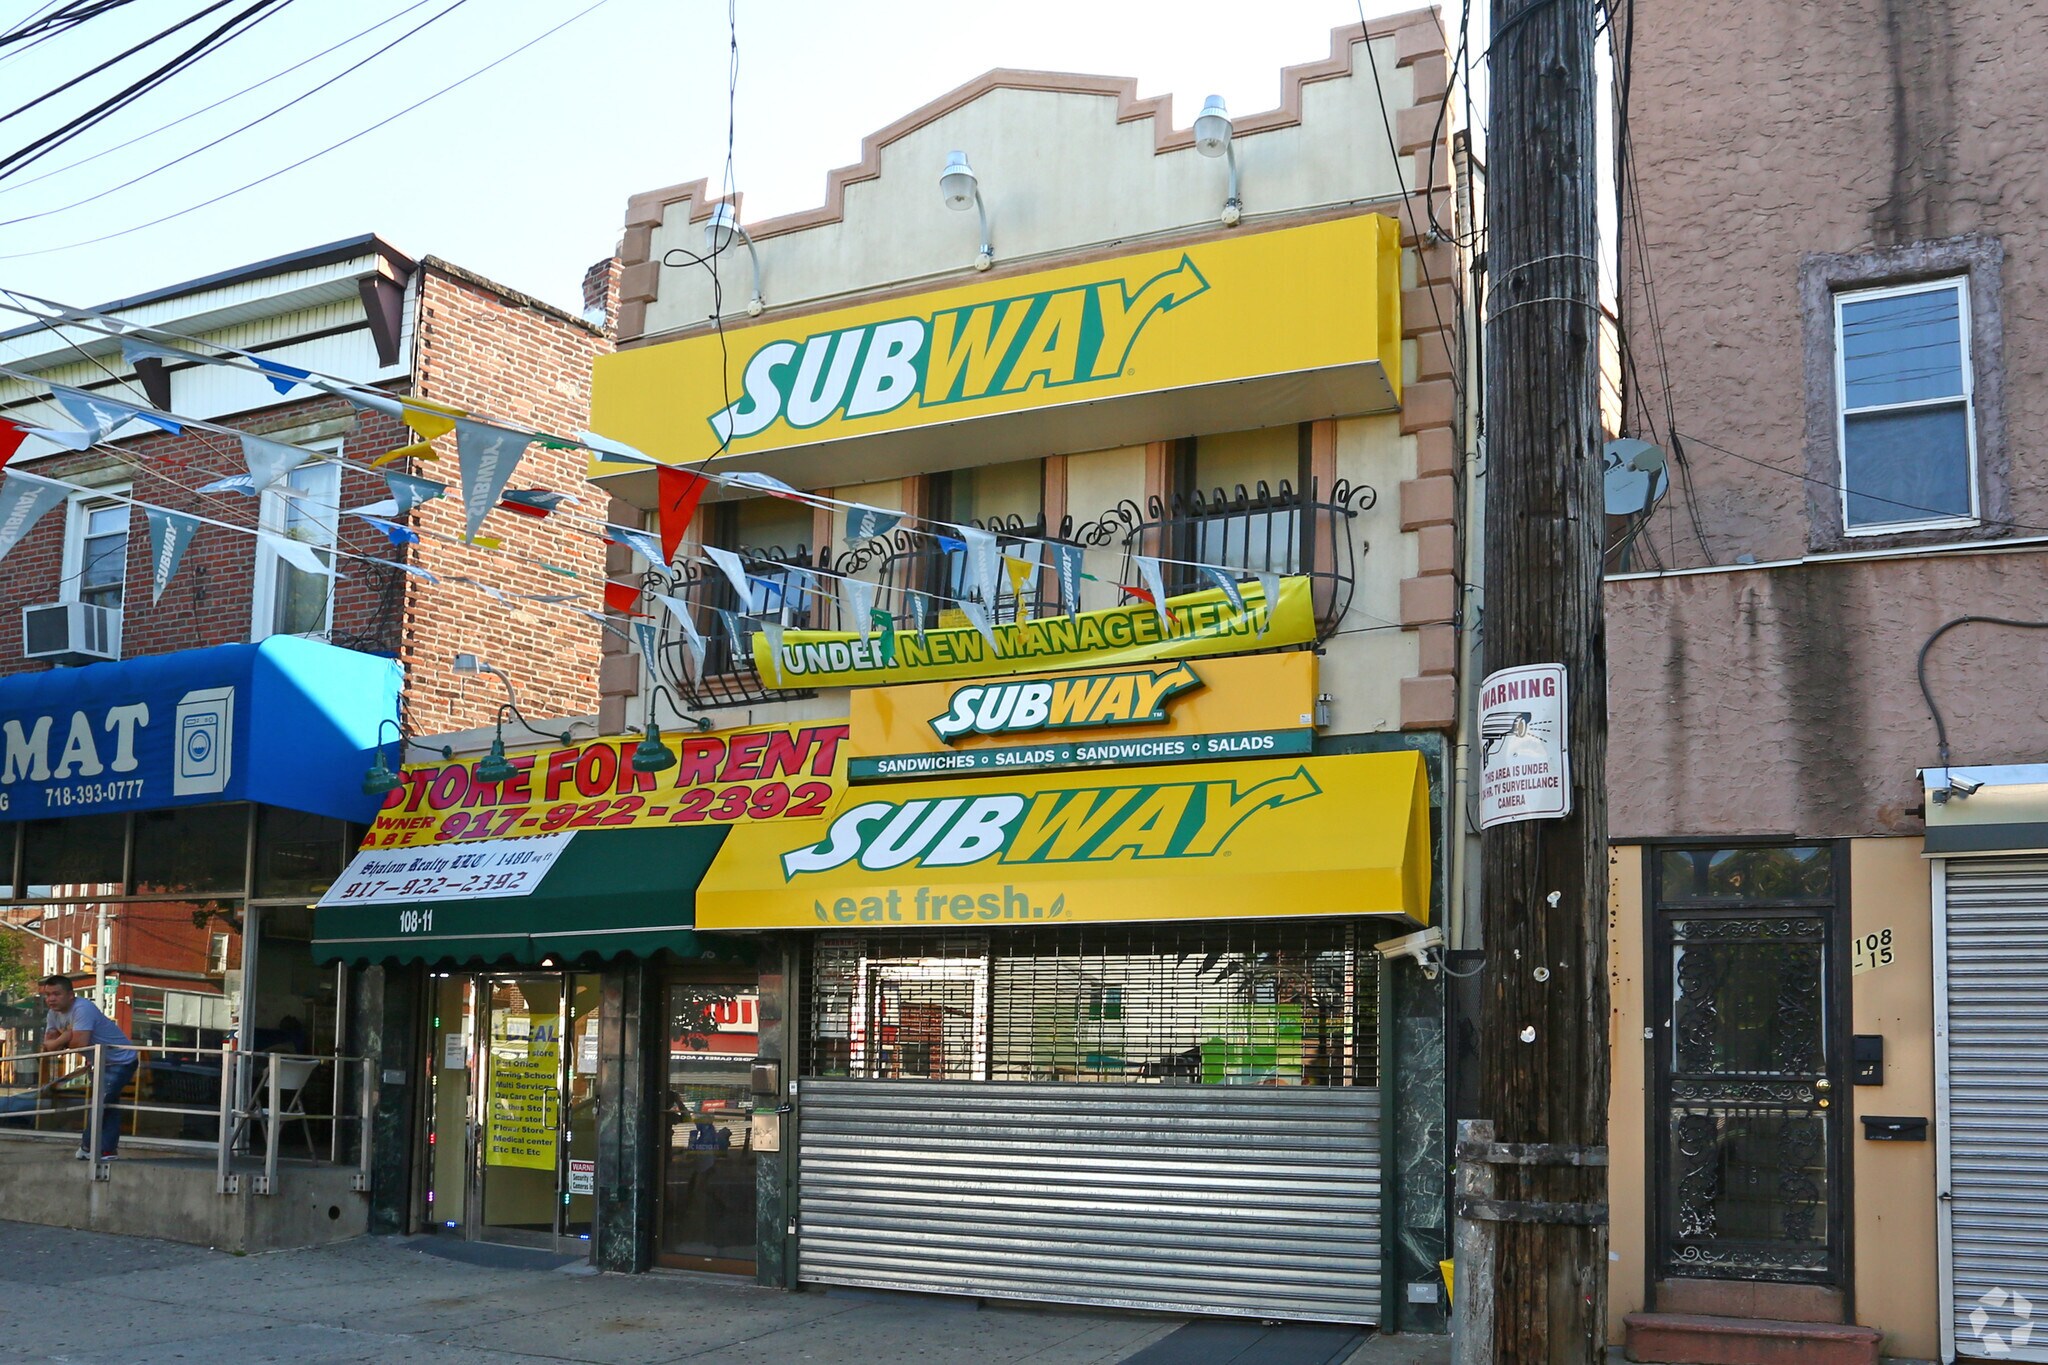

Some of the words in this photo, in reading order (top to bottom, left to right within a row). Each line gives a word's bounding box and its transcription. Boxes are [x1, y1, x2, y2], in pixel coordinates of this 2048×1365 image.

[707, 253, 1211, 452] SUBWAY
[155, 516, 179, 589] SUBWAY
[1061, 547, 1077, 612] SUBWAY
[782, 638, 900, 676] UNDER
[901, 630, 986, 668] NEW
[991, 595, 1271, 661] MANAGEMENT
[928, 661, 1206, 745] SUBWAY
[1482, 677, 1555, 711] WARNING
[1, 702, 149, 784] MAT
[877, 755, 975, 773] SANDWICHES
[995, 749, 1055, 766] SALADS
[1076, 742, 1185, 762] SANDWICHES
[1207, 735, 1274, 752] SALADS
[545, 741, 657, 801] FOR
[674, 724, 850, 788] RENT
[1485, 771, 1495, 784] THIS
[1495, 767, 1511, 781] AREA
[1512, 765, 1520, 777] IS
[1521, 762, 1549, 776] UNDER
[46, 779, 144, 807] 718-393-0777
[1494, 782, 1502, 795] TV
[1502, 776, 1559, 794] SURVEILLANCE
[434, 781, 832, 842] 917-922-2392
[1497, 794, 1526, 809] CAMERA
[376, 816, 436, 830] WNER
[780, 765, 1322, 883] SUBWAY
[359, 860, 407, 878] Shalom
[407, 857, 449, 873] Realty
[496, 850, 535, 866] 1480
[340, 871, 528, 899] 917-922-2392
[833, 888, 902, 922] eat
[915, 885, 1044, 921] fresh.
[400, 909, 433, 933] 108-11
[1855, 928, 1892, 955] 108
[495, 1071, 522, 1080] Driving
[524, 1072, 555, 1080] School
[496, 1081, 514, 1089] Multi
[495, 1092, 508, 1101] Day
[495, 1102, 524, 1111] Cthes
[527, 1104, 552, 1112] Stoe
[493, 1124, 520, 1133] Flower
[522, 1126, 544, 1134] Store
[525, 1115, 545, 1123] stor
[493, 1135, 525, 1144] Medical
[493, 1145, 509, 1153] Etc
[511, 1147, 525, 1155] Etc
[526, 1148, 541, 1156] Etc
[573, 1173, 589, 1183] Security
[573, 1182, 589, 1190] Cameras
